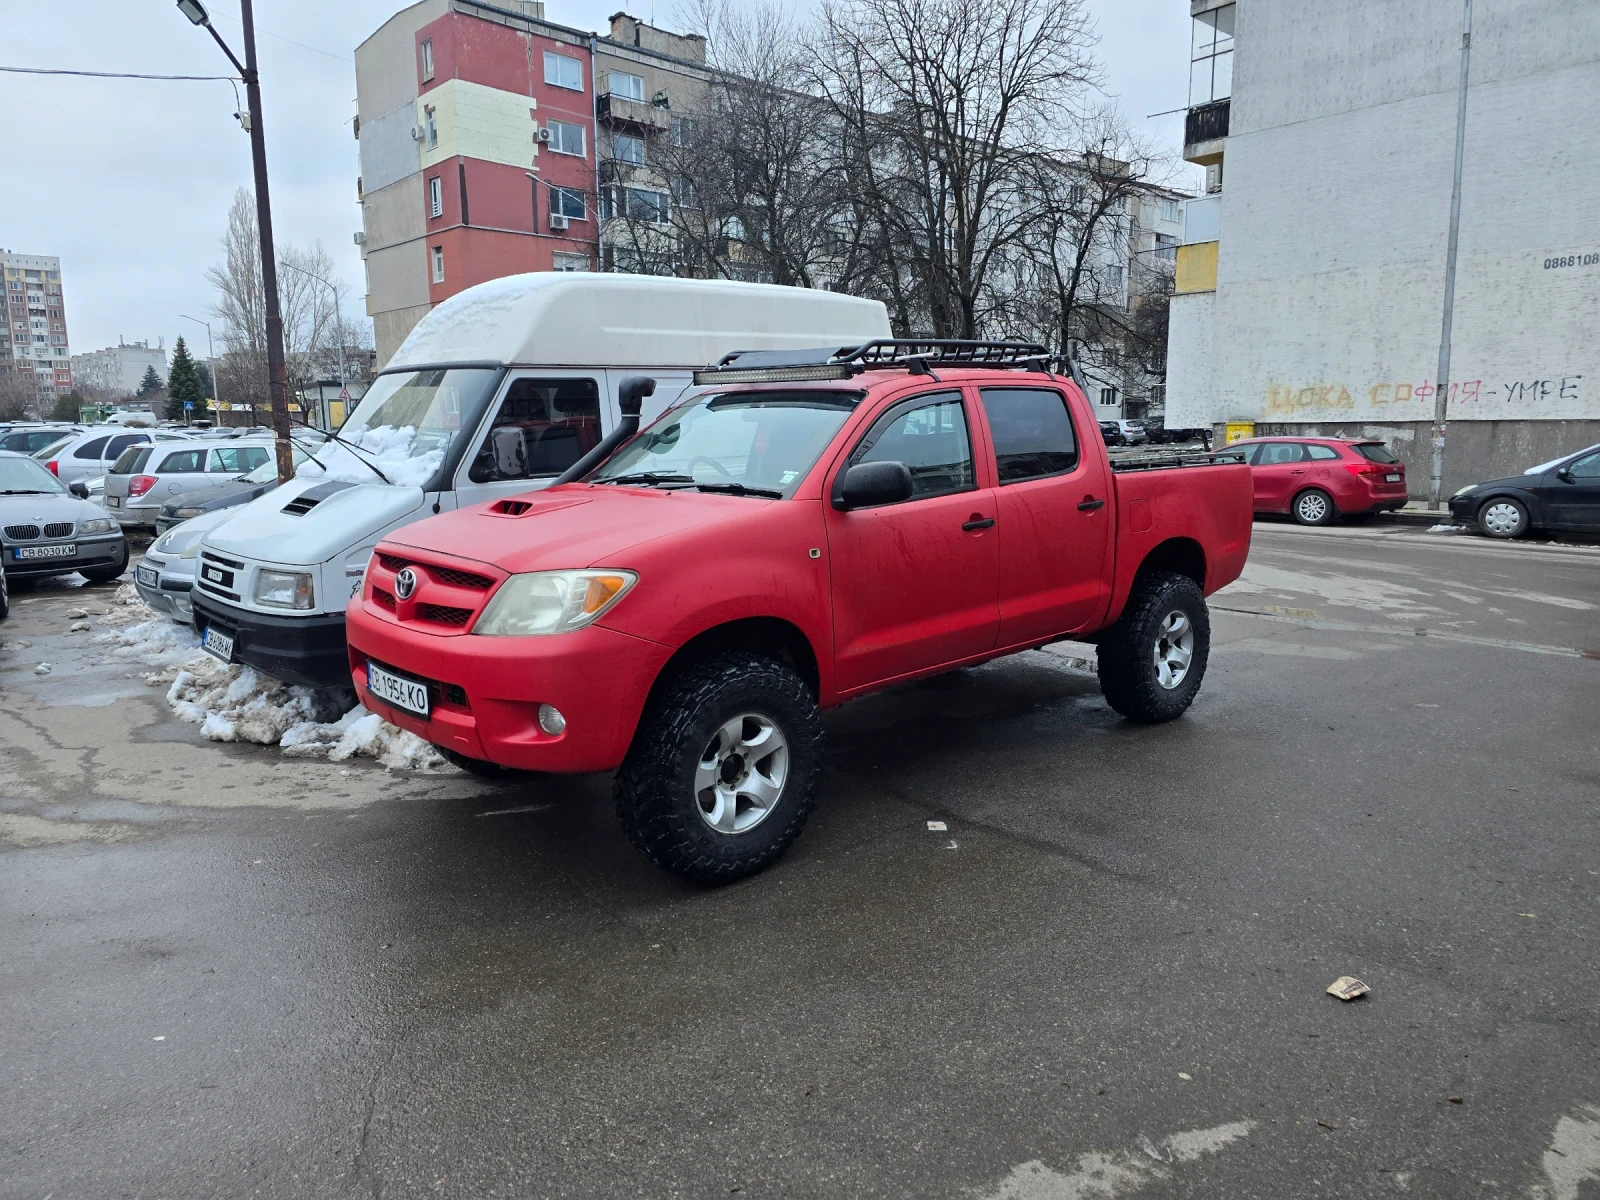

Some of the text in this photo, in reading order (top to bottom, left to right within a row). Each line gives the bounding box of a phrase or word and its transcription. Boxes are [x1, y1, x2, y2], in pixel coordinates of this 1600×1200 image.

[1543, 253, 1600, 269] 0888108
[22, 545, 75, 558] CB 8030 KM
